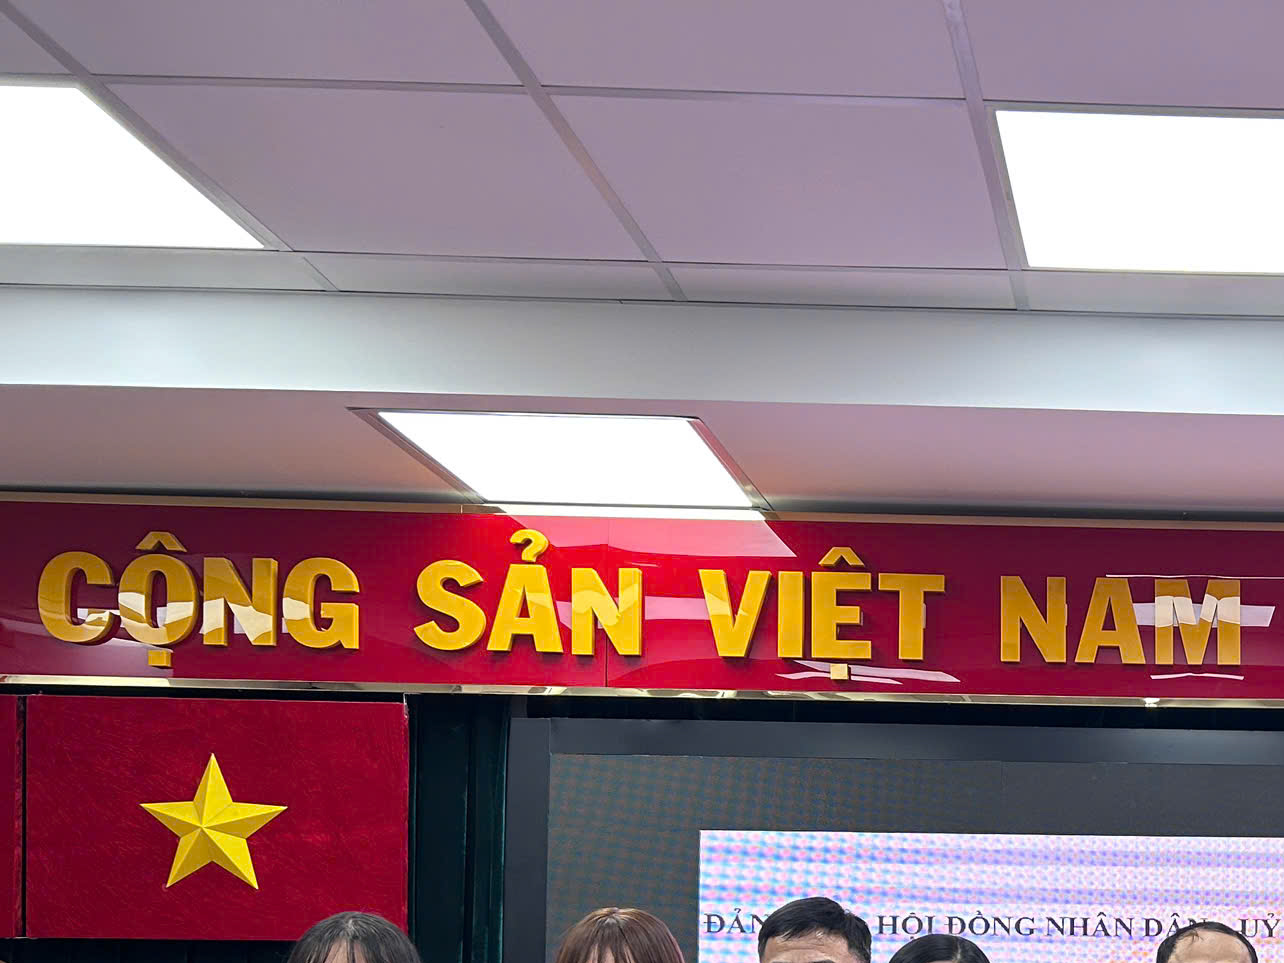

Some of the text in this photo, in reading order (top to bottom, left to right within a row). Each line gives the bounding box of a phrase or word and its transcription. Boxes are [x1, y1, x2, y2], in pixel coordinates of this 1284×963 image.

[36, 531, 361, 668] CỘNG
[413, 528, 643, 657] SẢN
[699, 546, 946, 681] VIỆT
[1001, 574, 1242, 666] NAM
[944, 910, 1036, 937] ĐỒNG
[1045, 911, 1134, 938] NHÂN
